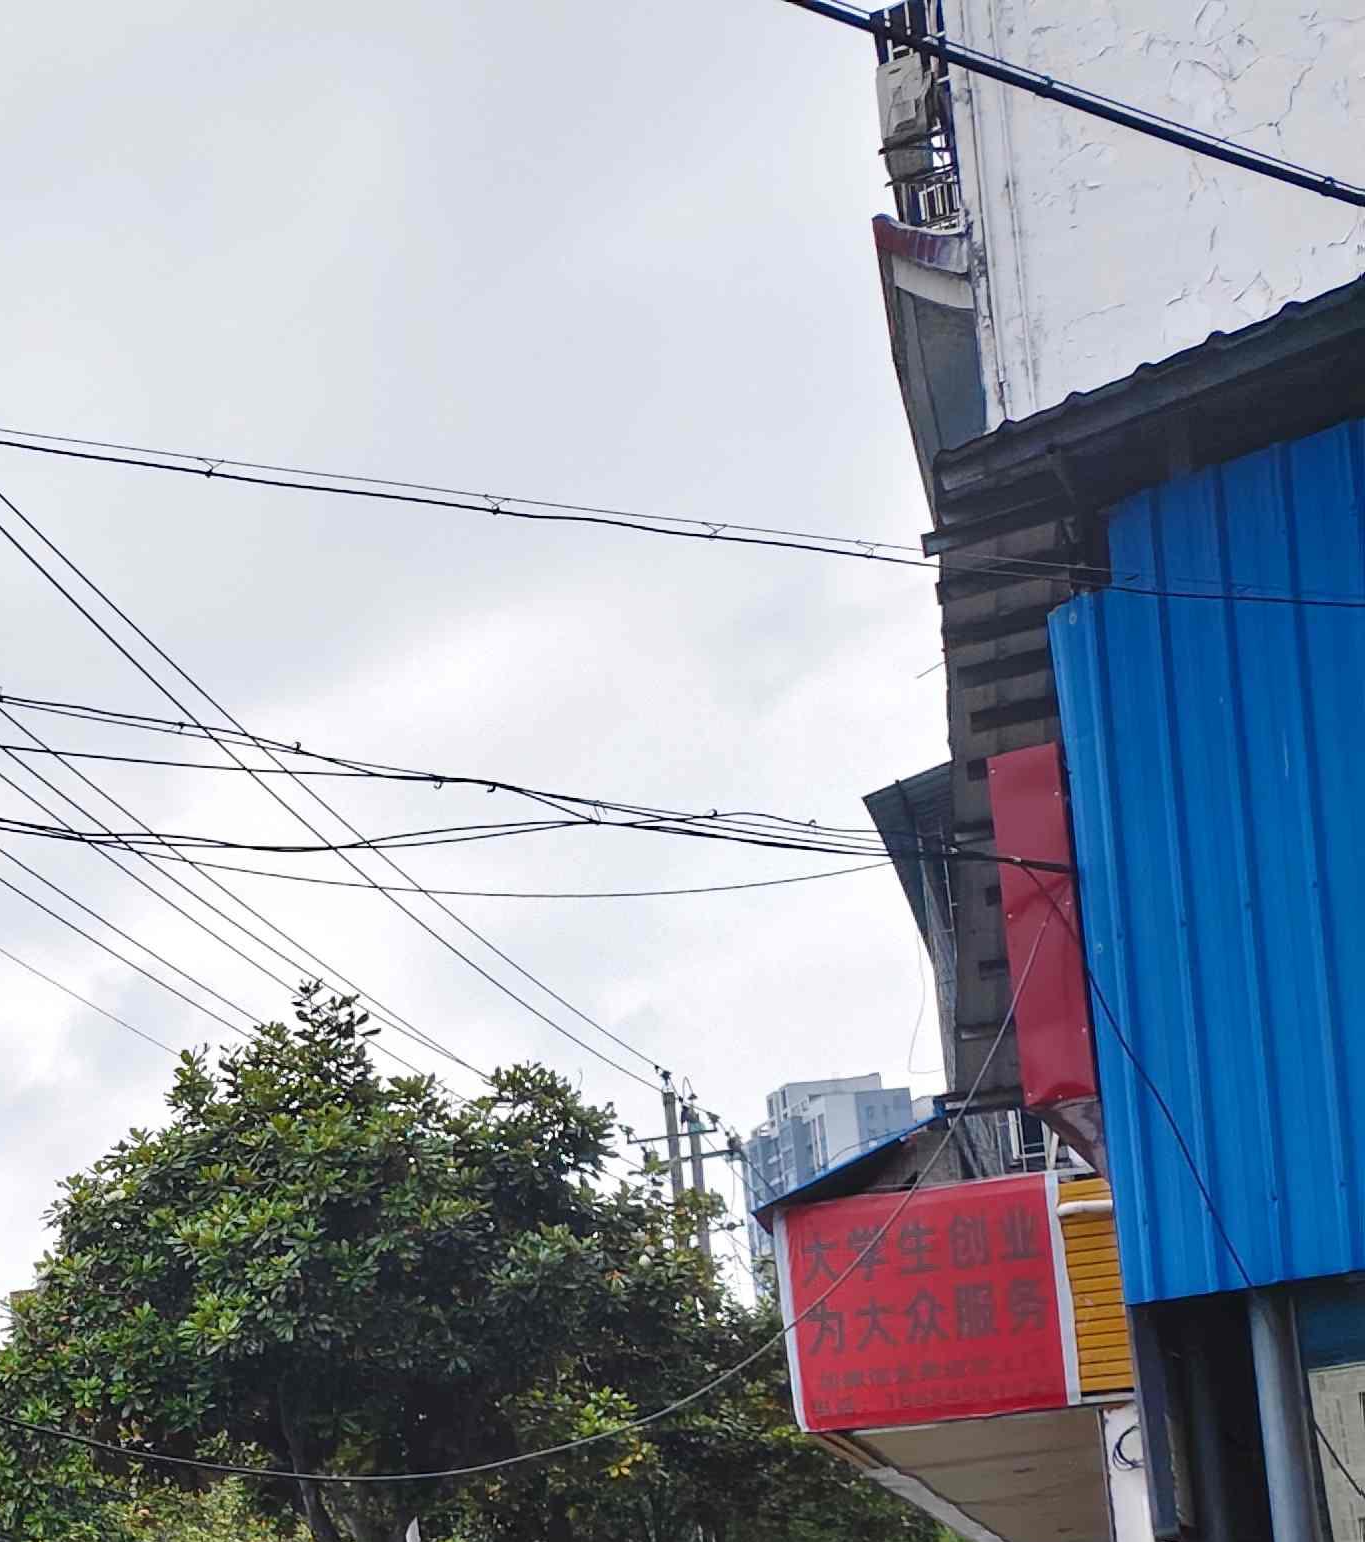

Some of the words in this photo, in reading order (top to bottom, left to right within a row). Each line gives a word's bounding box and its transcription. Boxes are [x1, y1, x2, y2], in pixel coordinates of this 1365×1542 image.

[800, 1205, 1042, 1288] 大学生创业
[805, 1278, 1050, 1356] 为大众服务
